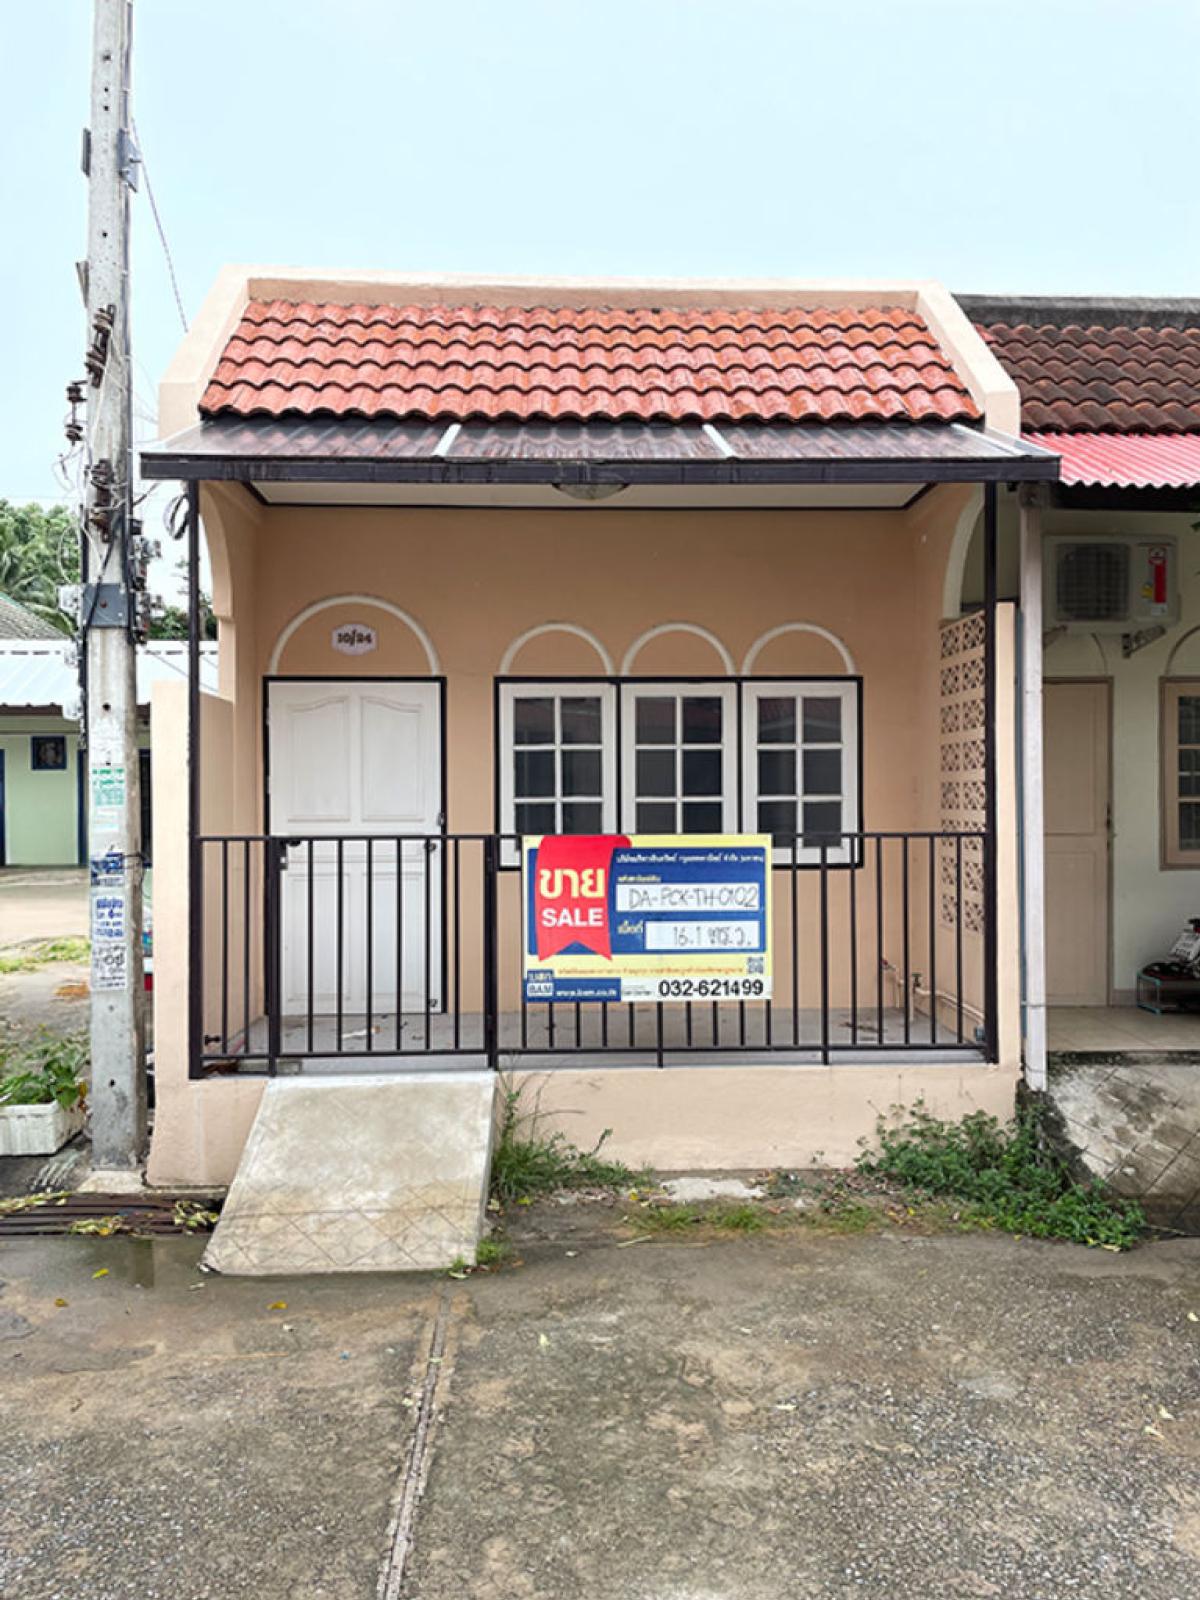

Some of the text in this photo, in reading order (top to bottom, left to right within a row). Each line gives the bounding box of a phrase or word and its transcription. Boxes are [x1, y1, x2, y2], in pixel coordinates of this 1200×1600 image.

[539, 868, 605, 899] ขาย
[541, 907, 604, 928] SALE
[658, 979, 764, 997] 032-621499
